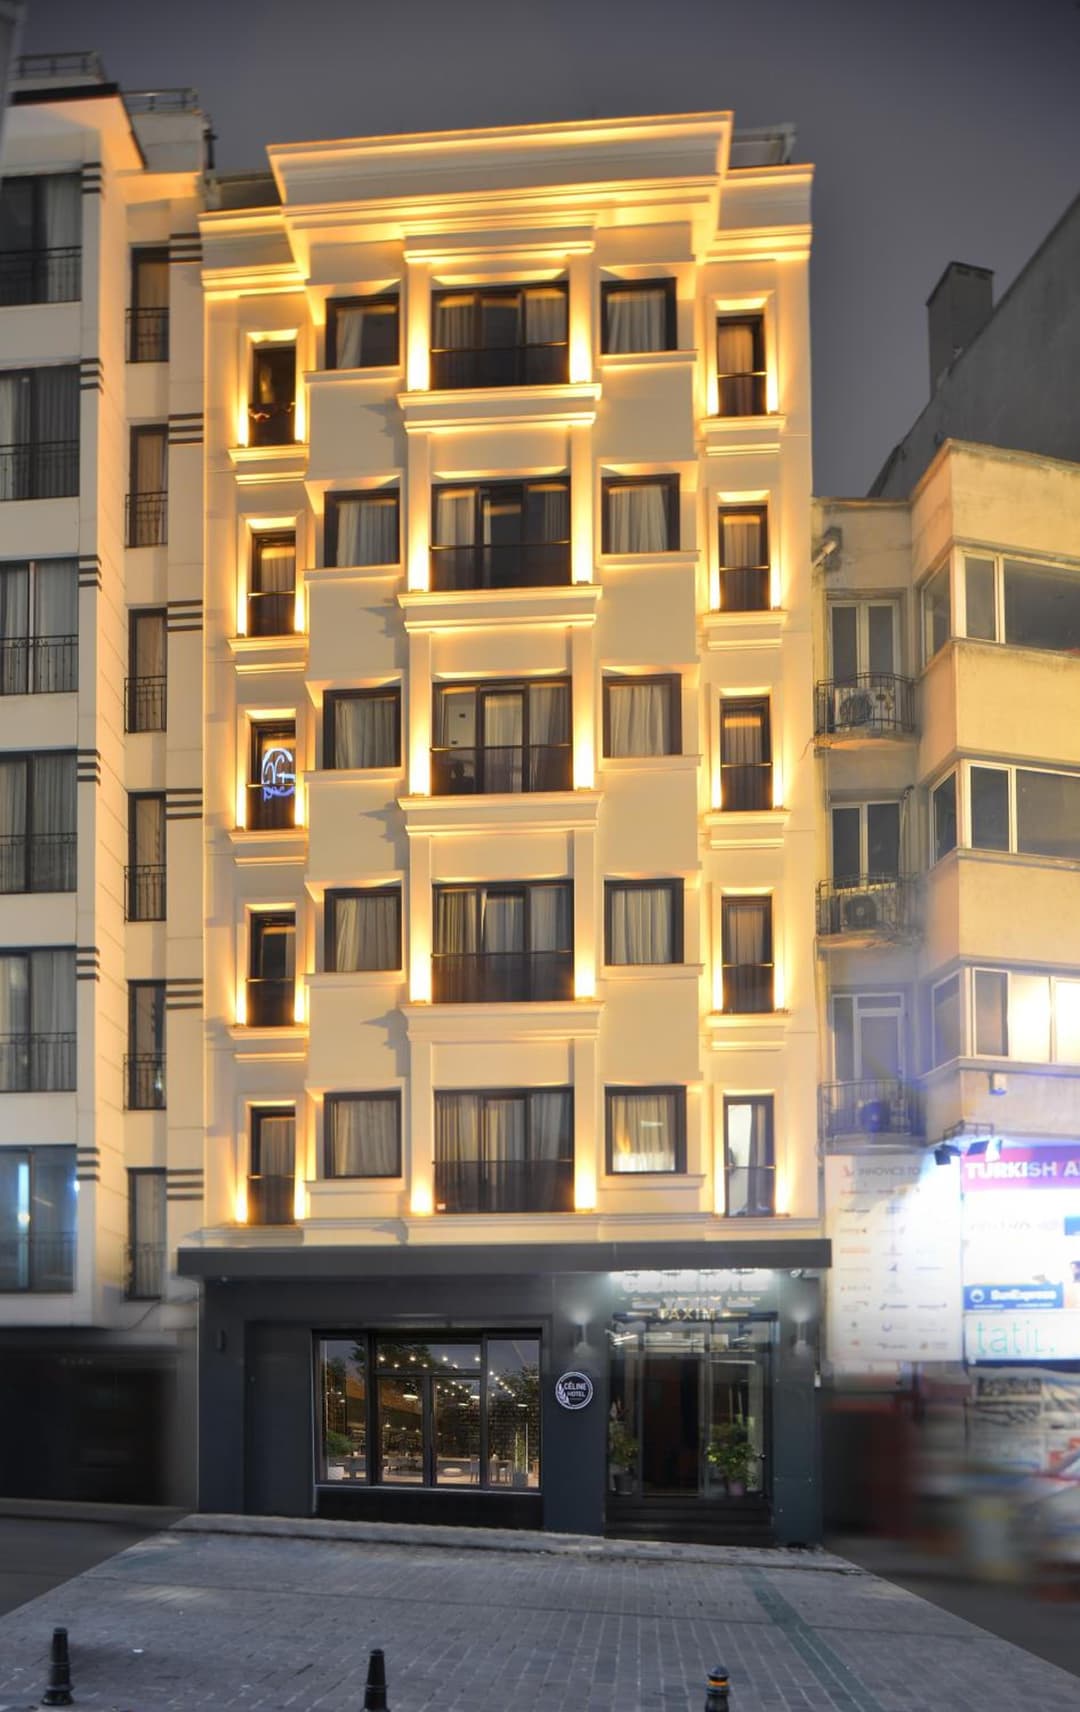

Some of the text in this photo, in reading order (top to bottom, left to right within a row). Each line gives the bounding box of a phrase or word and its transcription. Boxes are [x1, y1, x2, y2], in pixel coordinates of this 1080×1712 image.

[965, 1160, 1080, 1179] TURKISH A
[566, 1390, 586, 1398] HOTEL
